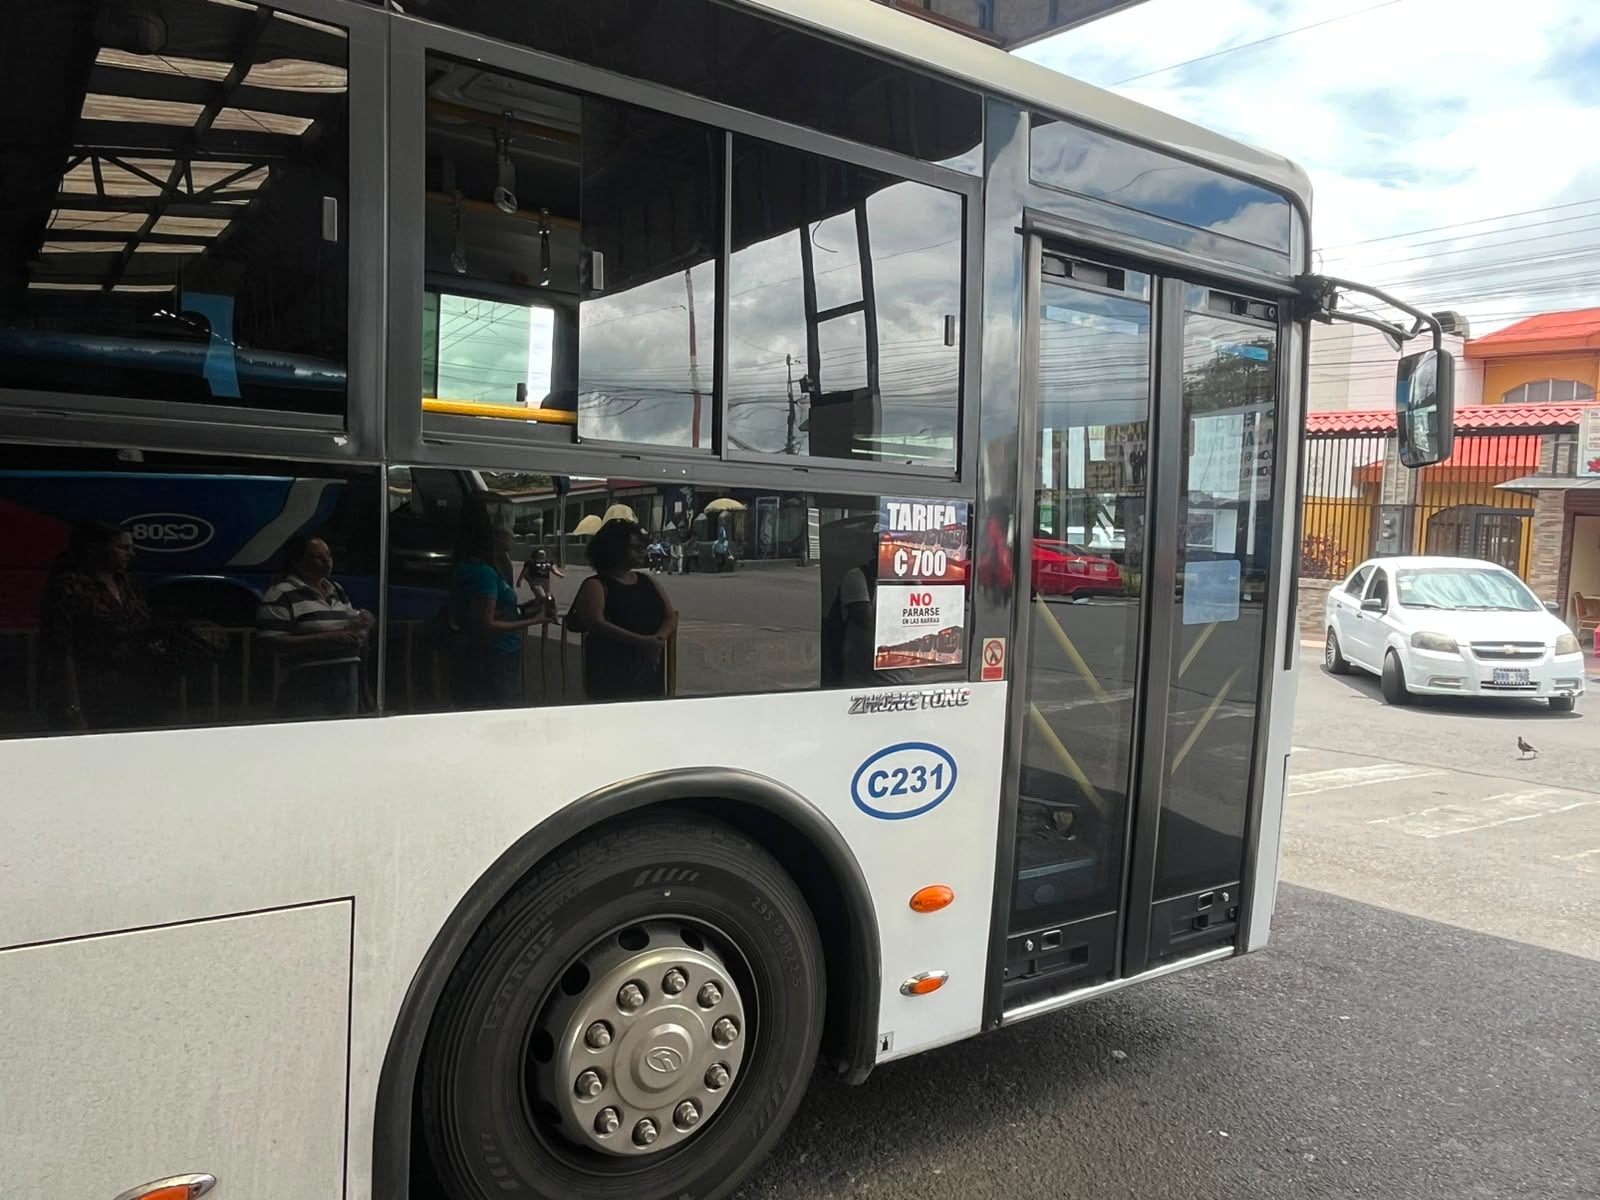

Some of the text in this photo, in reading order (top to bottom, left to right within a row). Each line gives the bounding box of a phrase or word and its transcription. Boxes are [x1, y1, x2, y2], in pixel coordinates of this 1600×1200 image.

[887, 503, 957, 531] TARIFA
[911, 550, 947, 576] 700
[902, 607, 940, 617] PARARSE
[910, 593, 932, 606] NO
[867, 763, 944, 799] C231
